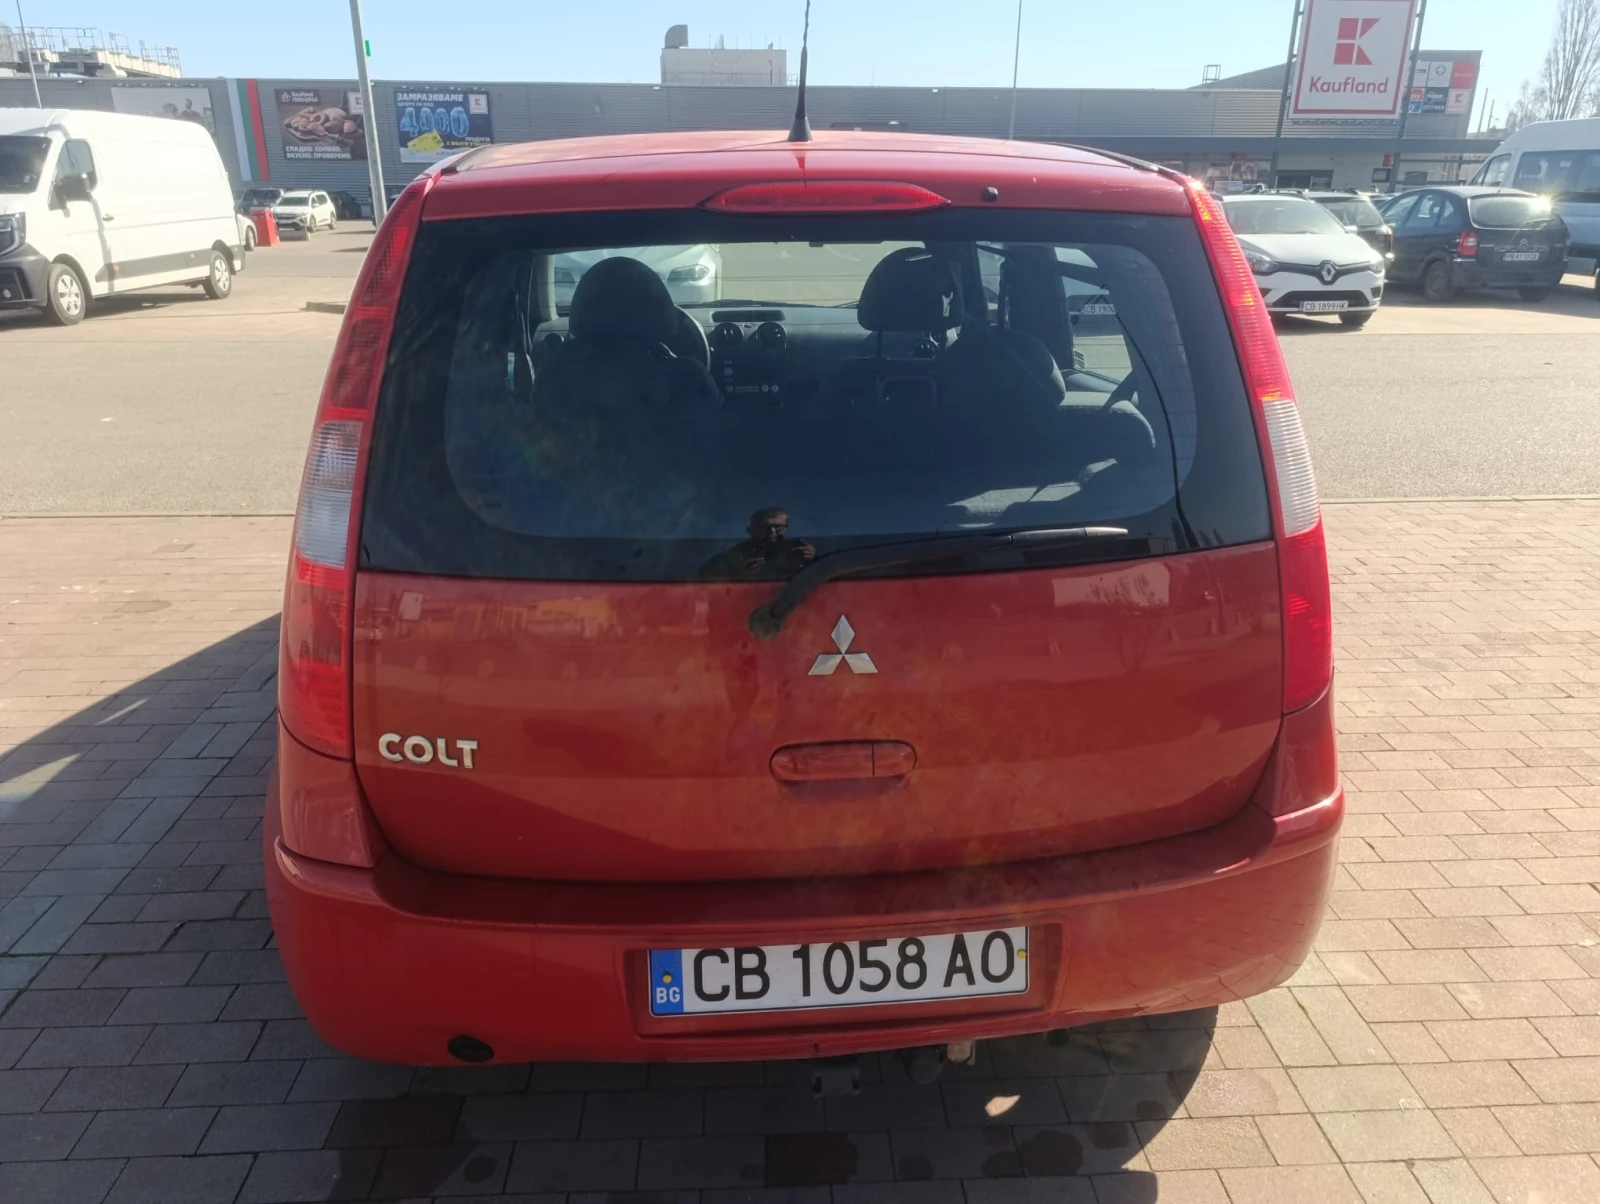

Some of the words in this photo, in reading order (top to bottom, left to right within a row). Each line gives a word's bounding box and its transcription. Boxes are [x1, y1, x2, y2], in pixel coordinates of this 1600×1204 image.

[1309, 76, 1389, 94] Kaufland
[397, 93, 464, 102] ЗАМРАЗЯВАМЕ
[401, 107, 469, 137] 4000
[378, 733, 478, 768] COLT
[693, 947, 770, 1002] CB
[793, 937, 928, 997] 1058
[943, 930, 1015, 988] AO
[656, 987, 681, 1004] BG
